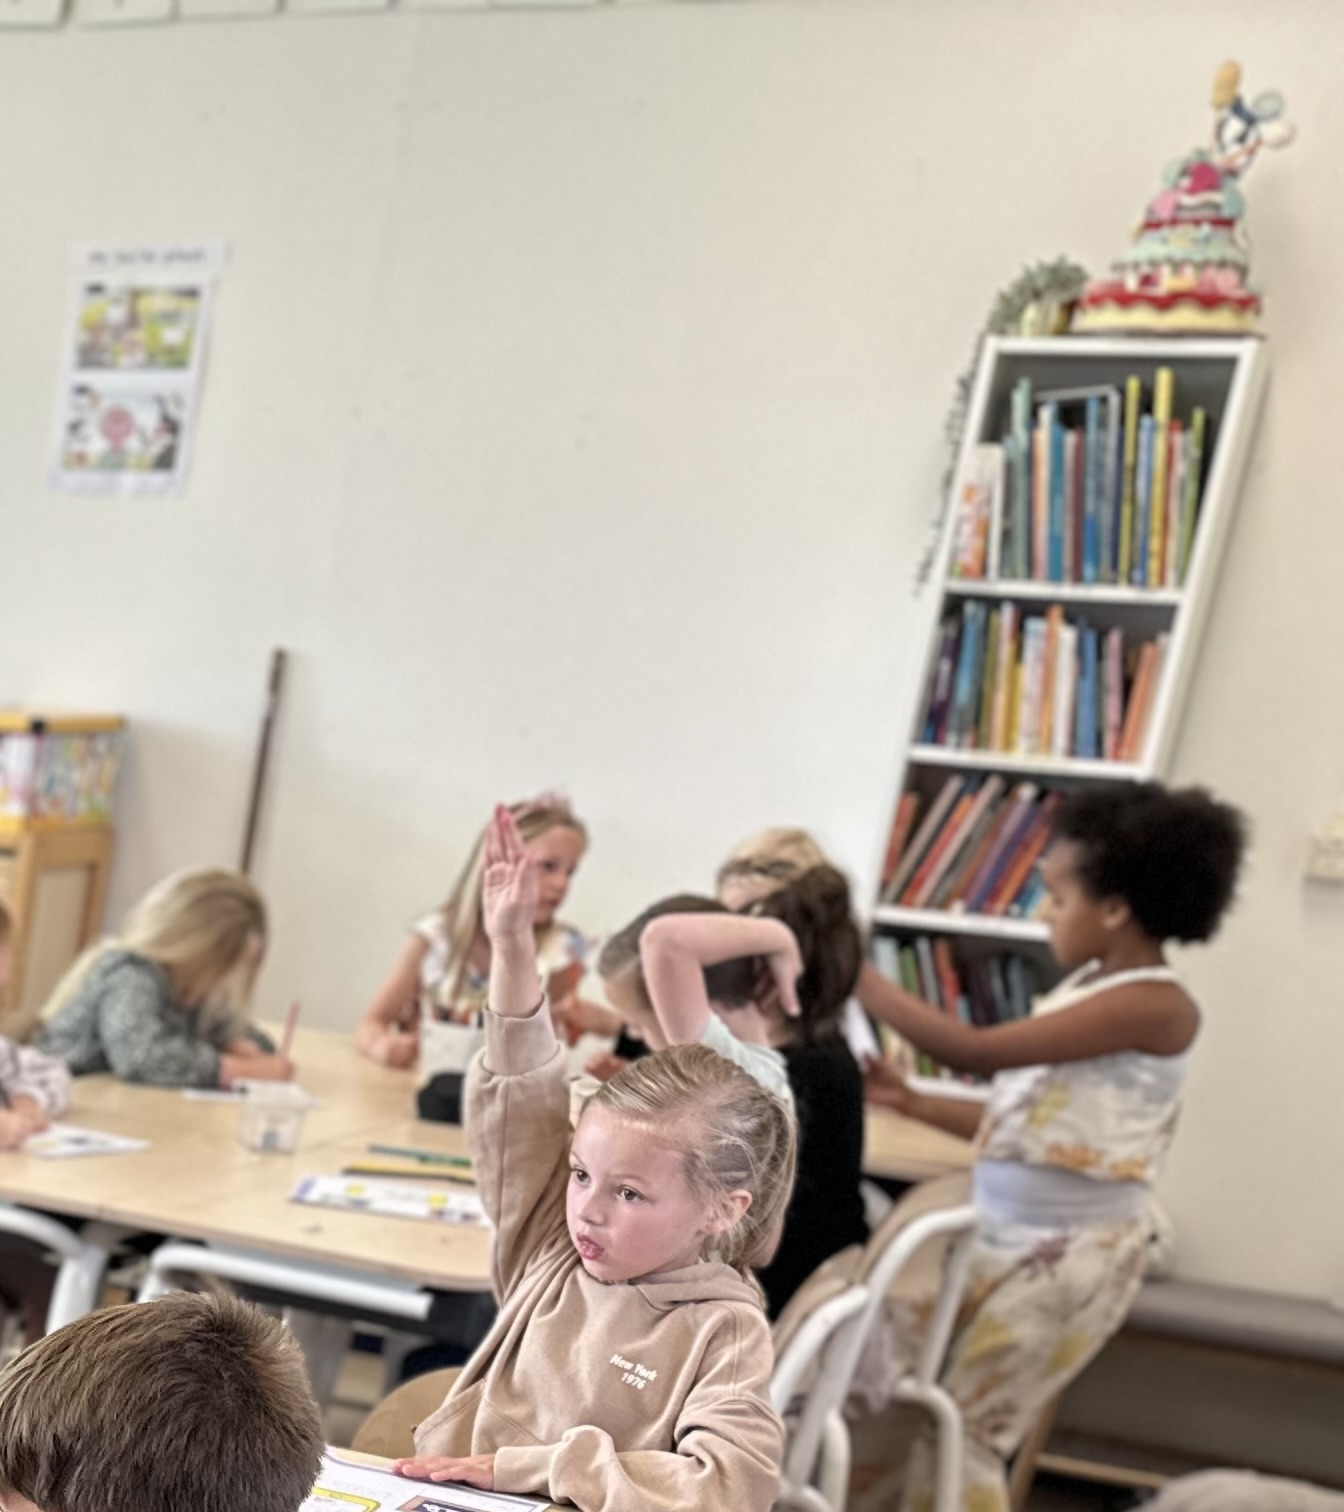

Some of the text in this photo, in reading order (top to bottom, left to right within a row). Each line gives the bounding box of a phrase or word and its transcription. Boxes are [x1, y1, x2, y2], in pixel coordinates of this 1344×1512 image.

[610, 1354, 657, 1381] New York
[621, 1372, 646, 1389] 1976
